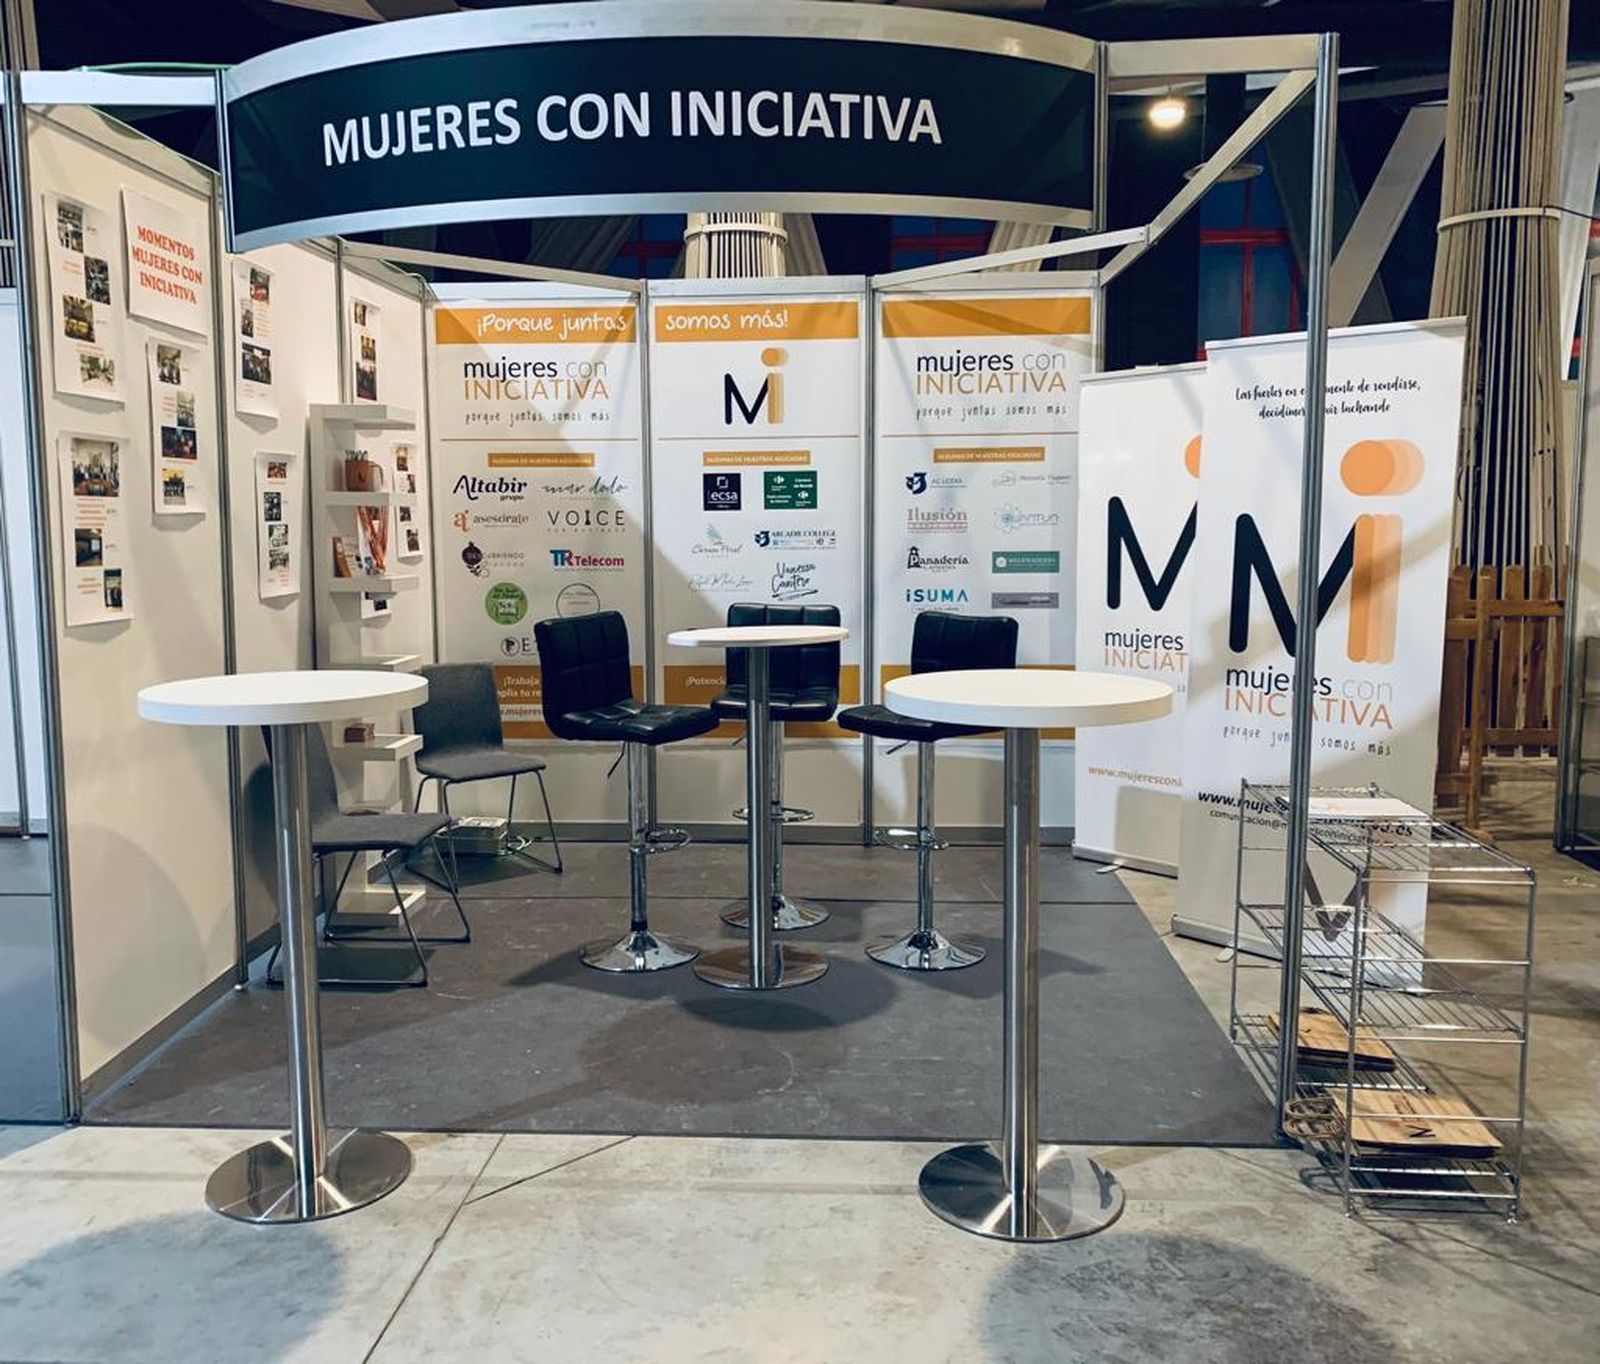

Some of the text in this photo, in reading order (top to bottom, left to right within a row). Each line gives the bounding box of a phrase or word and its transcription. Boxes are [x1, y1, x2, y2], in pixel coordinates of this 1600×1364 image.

[321, 90, 944, 168] MUJERES CON INICIATIVA
[137, 225, 196, 262] MOMENTOS
[132, 245, 203, 284] MUJERES CON
[139, 271, 198, 304] INICIATIVA
[476, 313, 627, 340] ¡Porque juntas
[664, 310, 789, 331] somos más!
[463, 356, 608, 384] mujeres con
[916, 350, 1066, 377] mujeres con
[463, 379, 610, 401] INICIATIVA
[915, 371, 1067, 395] INICIATIVA
[1285, 388, 1297, 397] en
[1357, 378, 1371, 393] de
[464, 412, 501, 426] porque
[509, 412, 544, 428] juntas
[915, 403, 1067, 422] porque juntas somos más
[453, 475, 528, 501] Altabir
[710, 490, 738, 500] ecsa
[547, 510, 626, 526] VOICE
[907, 507, 968, 521] Ilusión
[574, 554, 625, 567] Telecom
[1104, 628, 1185, 652] mujeres
[1103, 648, 1189, 673] INICIAT
[1341, 678, 1393, 701] con
[1224, 687, 1394, 730] INICTIVA
[1223, 724, 1261, 742] porque
[1320, 736, 1357, 752] somos
[1367, 740, 1392, 756] más
[1088, 765, 1184, 788] www.mujeresconi
